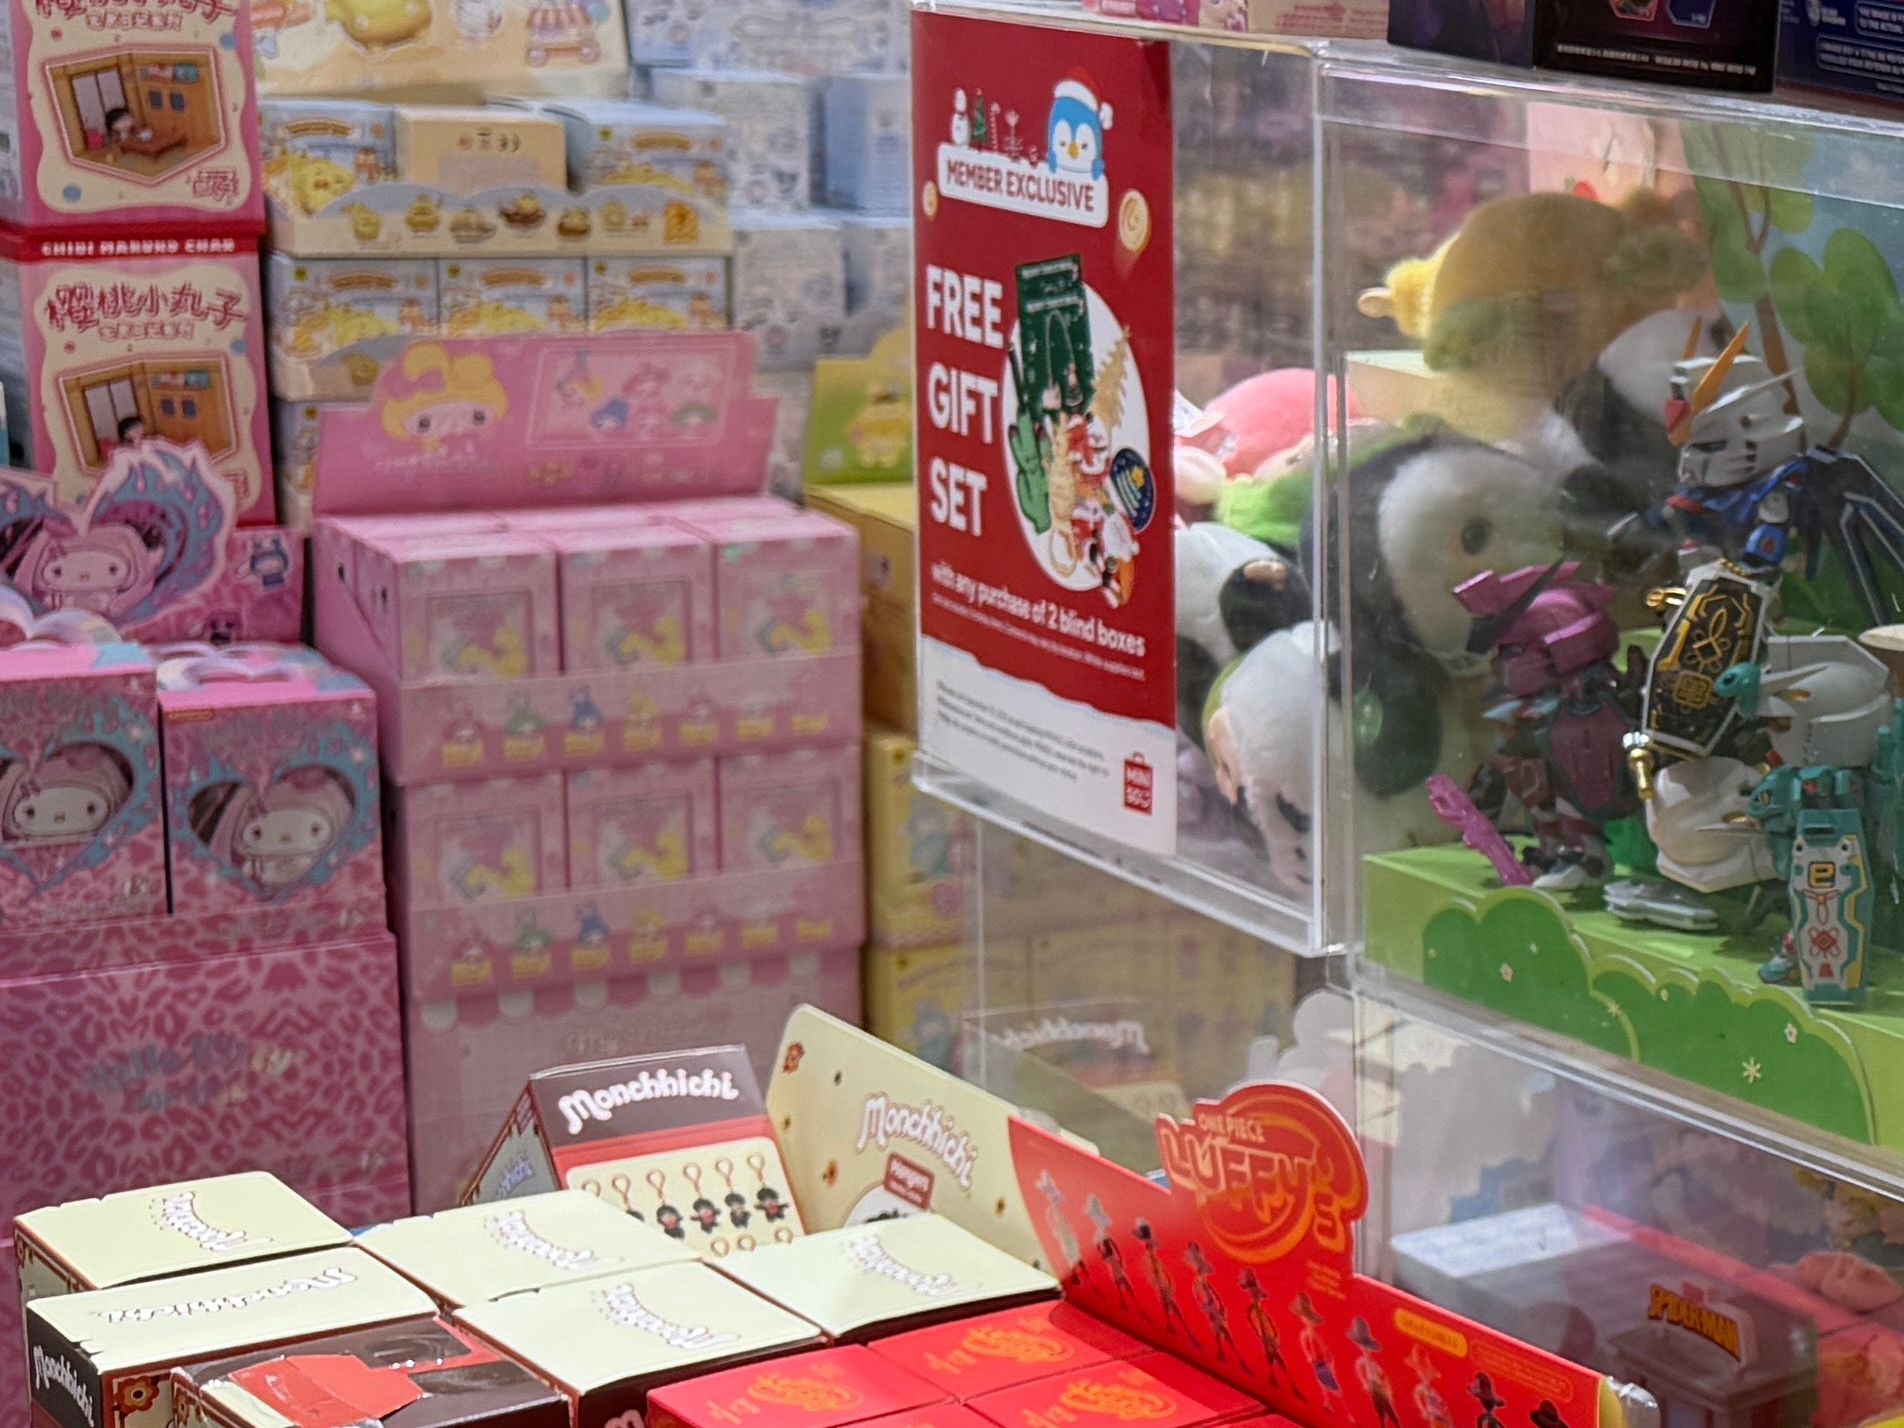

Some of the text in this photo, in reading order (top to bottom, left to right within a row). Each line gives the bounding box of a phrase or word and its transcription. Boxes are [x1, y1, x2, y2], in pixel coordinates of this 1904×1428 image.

[945, 155, 1095, 214] MEMBER EXCLUSIVE
[926, 263, 1003, 350] FREE
[928, 363, 999, 444] GIFT
[929, 458, 988, 538] SET
[954, 571, 977, 600] any
[978, 580, 1027, 618] purchase
[1029, 599, 1046, 624] of
[1047, 605, 1057, 627] 2
[1060, 605, 1094, 645] blind
[1097, 622, 1146, 657] boxes
[558, 1069, 739, 1134] Monchhichi
[859, 1093, 980, 1191] Monchhichi
